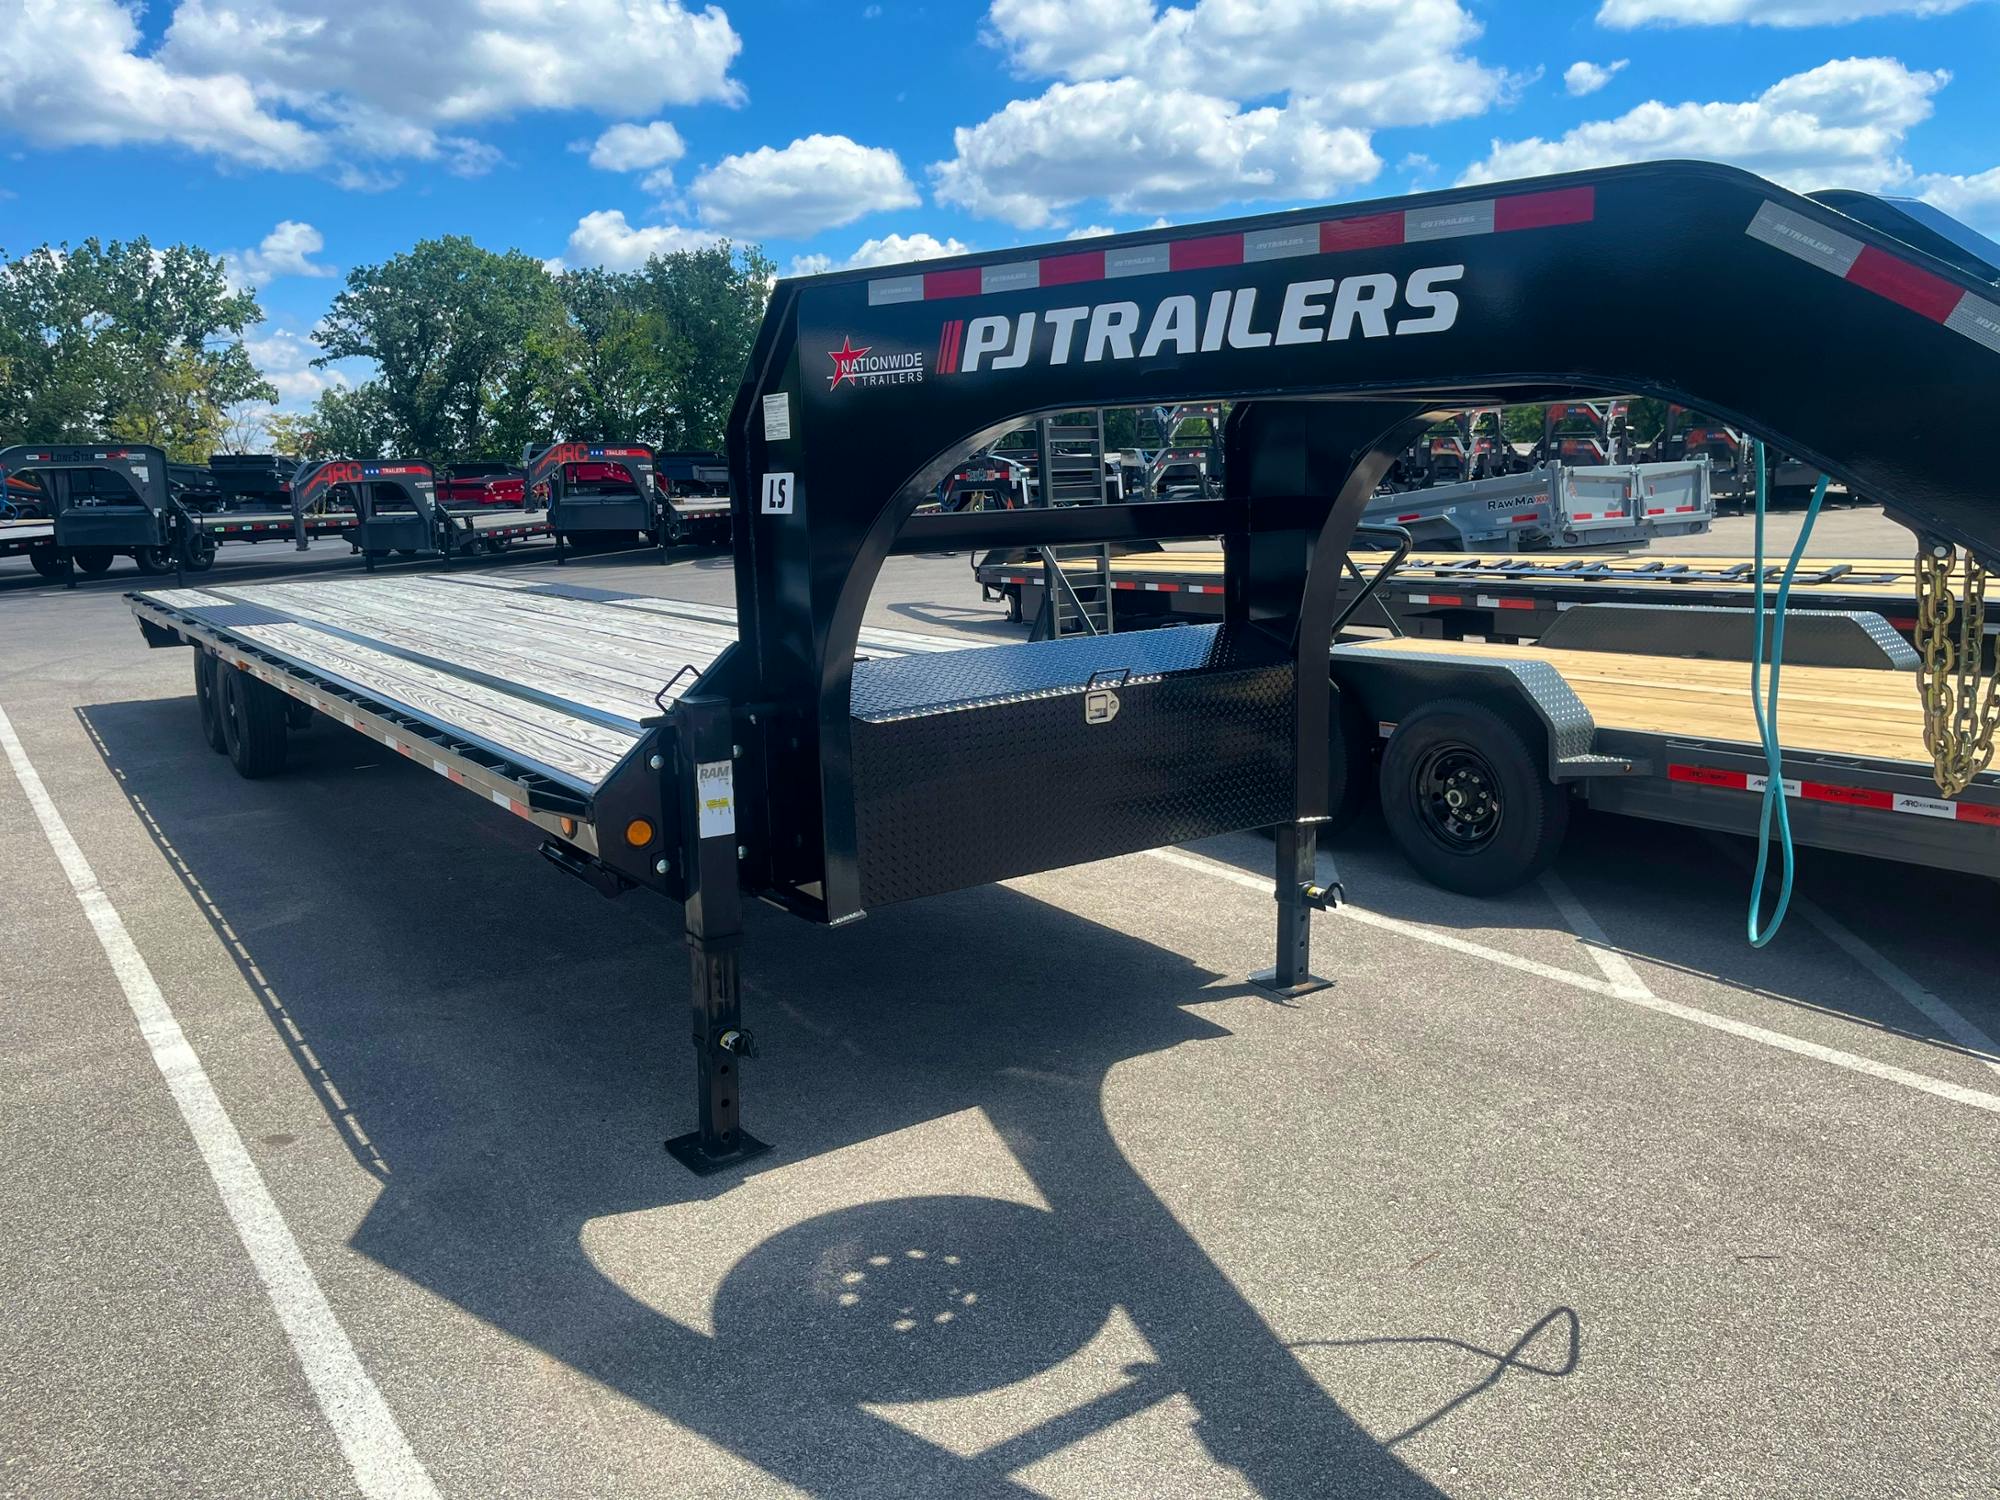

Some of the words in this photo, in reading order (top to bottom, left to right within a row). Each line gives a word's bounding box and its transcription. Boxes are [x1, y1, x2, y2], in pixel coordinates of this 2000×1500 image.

[841, 352, 923, 373] NATIONWIDE
[861, 371, 924, 387] TRAILERS
[768, 478, 787, 508] LS
[700, 765, 730, 780] RAM
